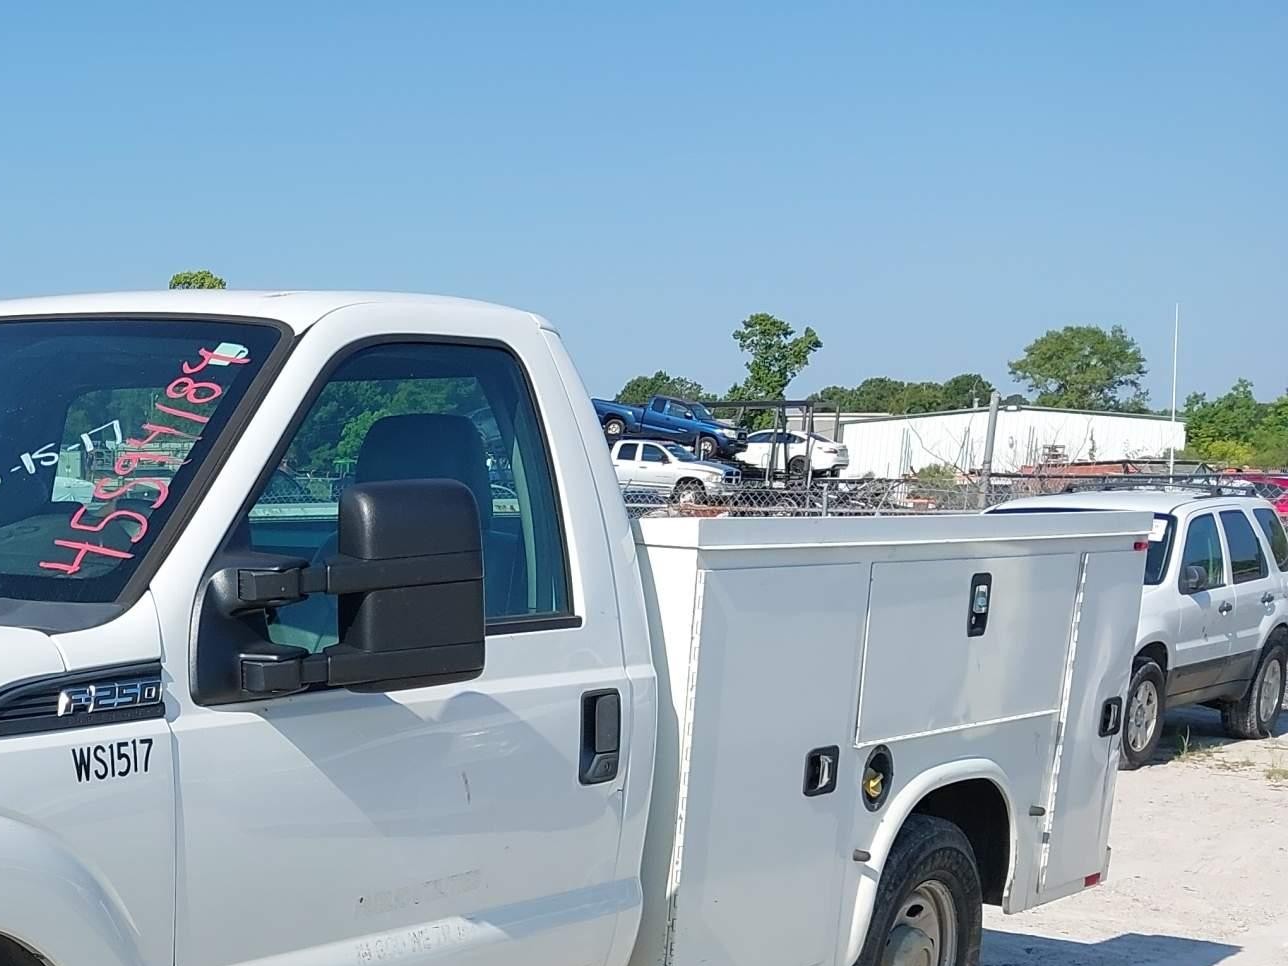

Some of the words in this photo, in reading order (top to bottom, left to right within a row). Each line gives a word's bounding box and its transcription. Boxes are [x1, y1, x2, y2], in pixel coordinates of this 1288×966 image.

[39, 347, 251, 575] 45594184
[57, 680, 162, 717] F-250
[71, 738, 154, 783] WS1517
